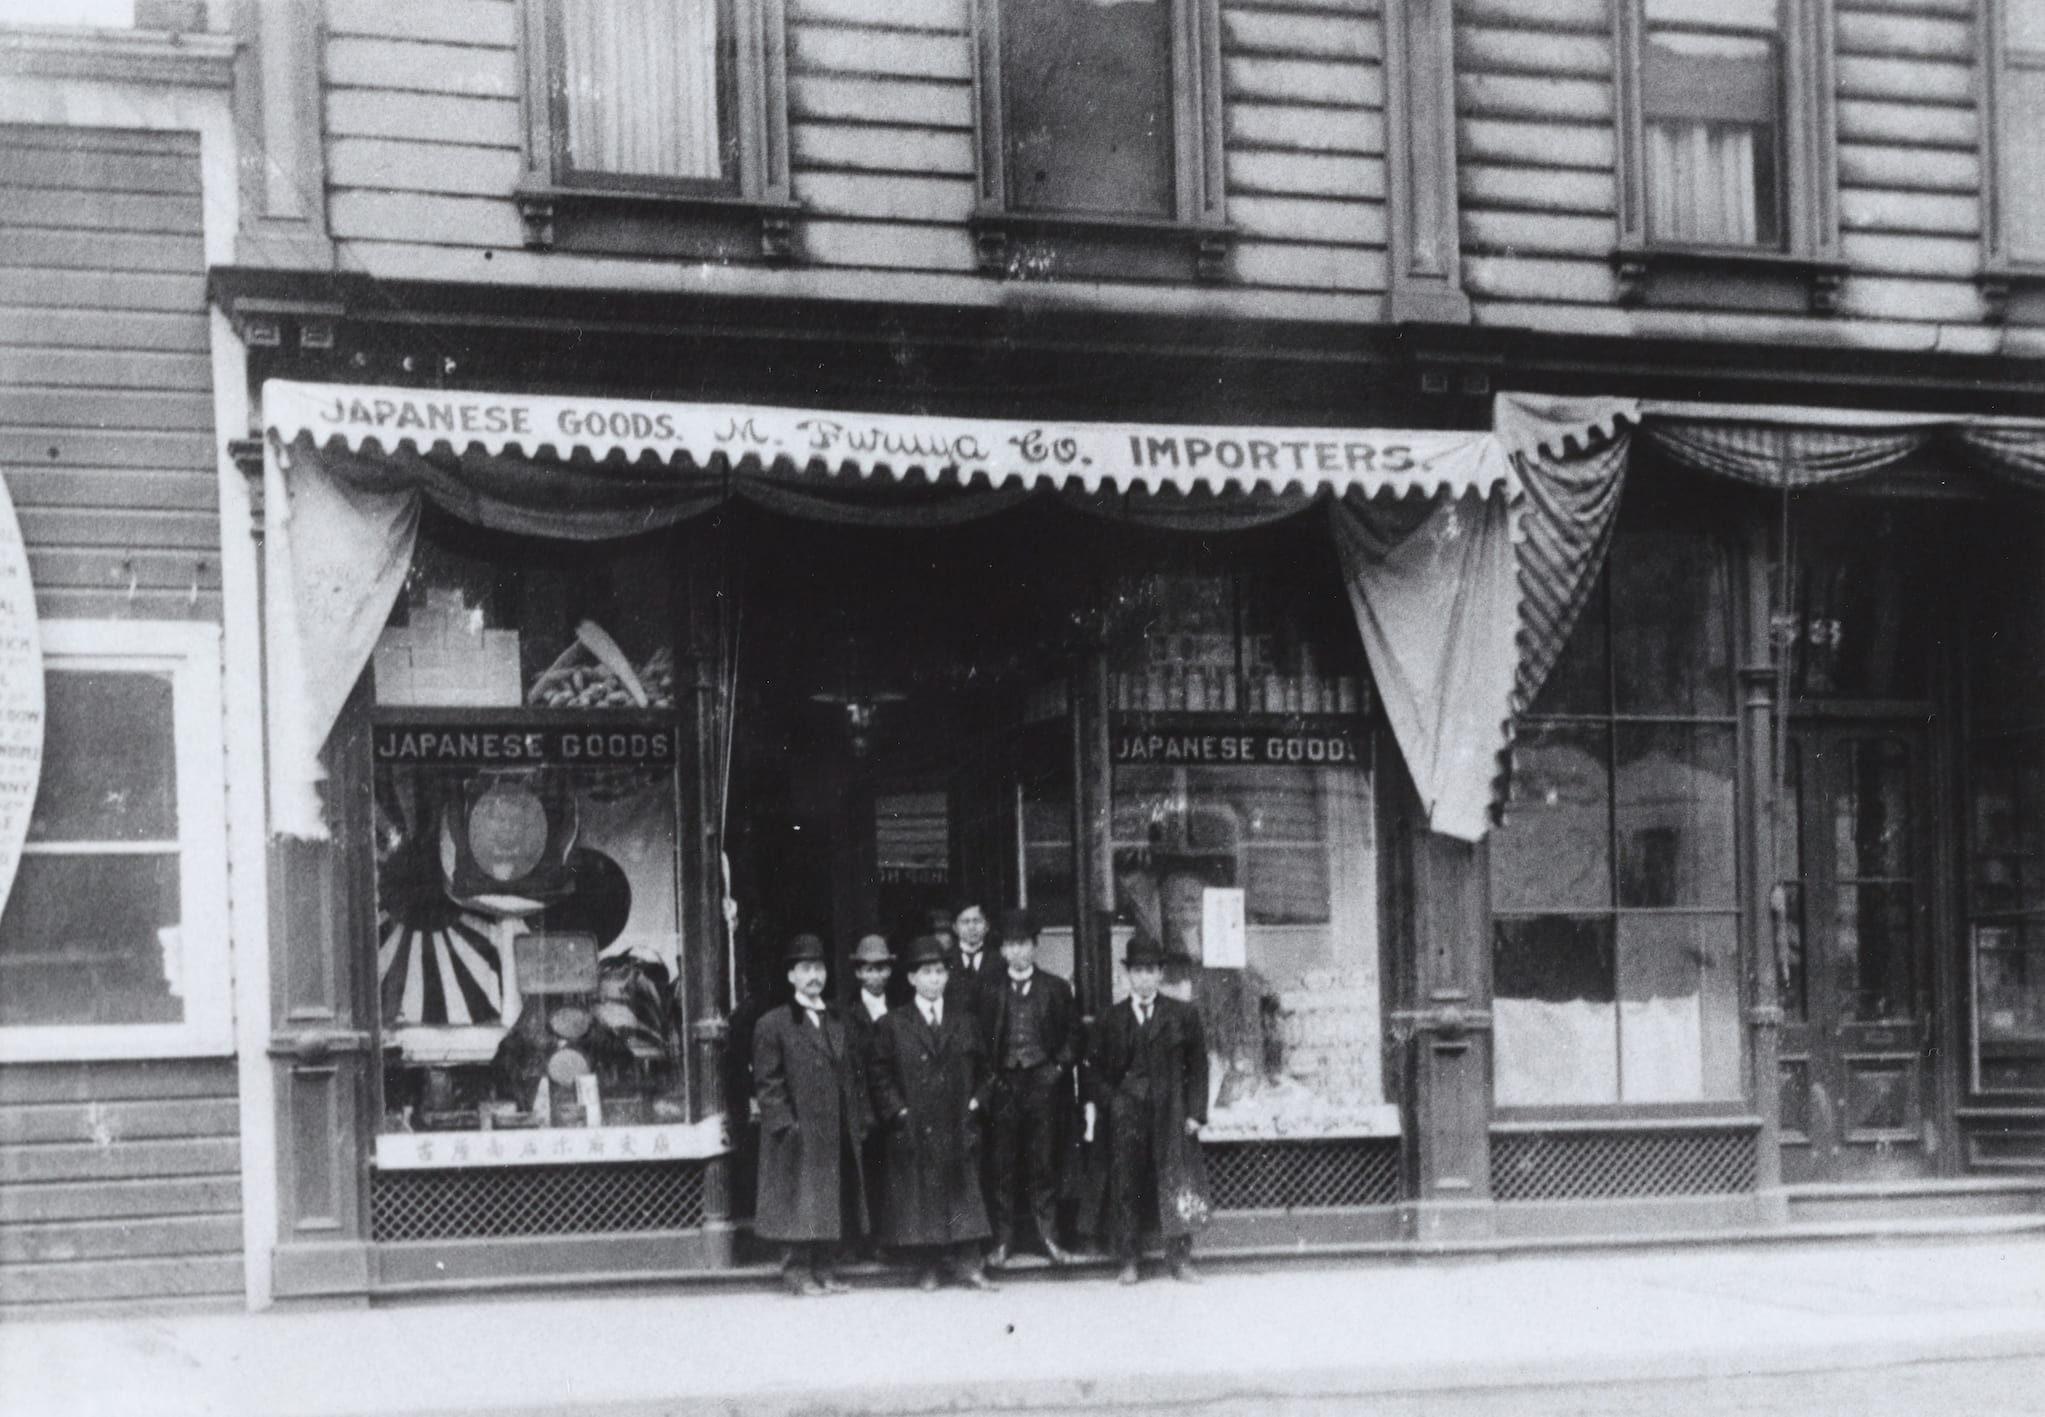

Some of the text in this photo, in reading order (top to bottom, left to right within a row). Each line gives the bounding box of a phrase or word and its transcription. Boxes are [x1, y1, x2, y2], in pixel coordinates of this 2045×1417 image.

[320, 397, 1435, 474] JAPANESE GOODS. M. Furuya Co. IMPORTERS.
[379, 732, 668, 758] JAPANESE GOODS
[1117, 737, 1255, 760] JAPANESE
